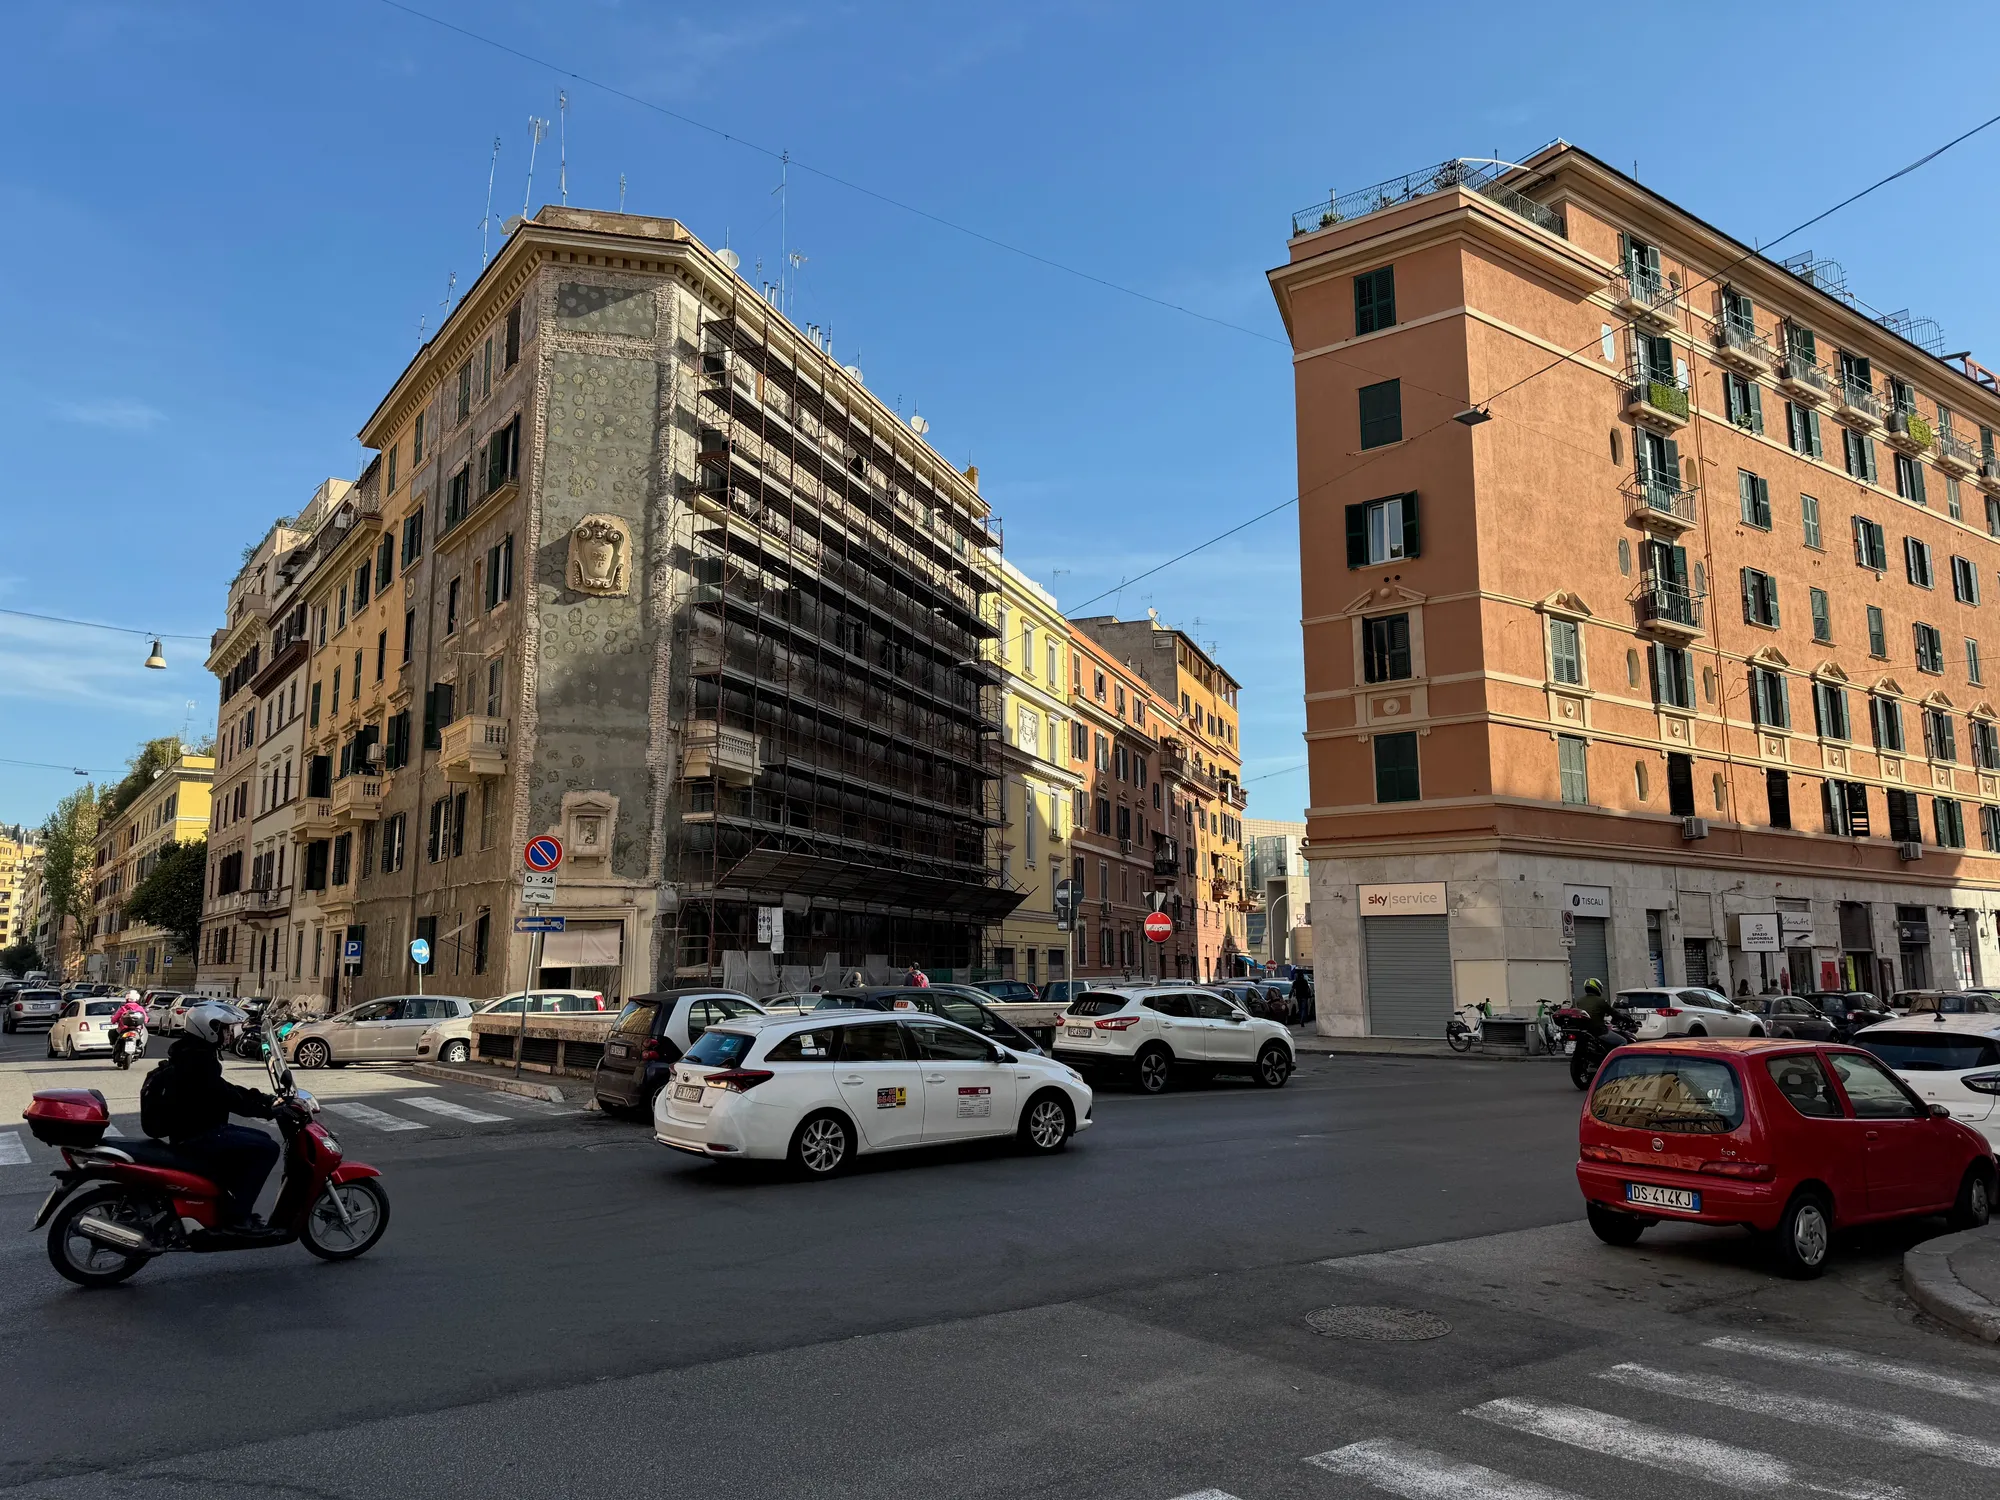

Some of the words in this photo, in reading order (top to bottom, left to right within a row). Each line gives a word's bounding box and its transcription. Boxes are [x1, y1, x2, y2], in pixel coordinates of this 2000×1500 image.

[526, 875, 533, 883] 0
[1368, 893, 1388, 906] sky
[1391, 892, 1438, 904] service
[1581, 897, 1604, 906] TISCALI
[347, 942, 359, 955] P
